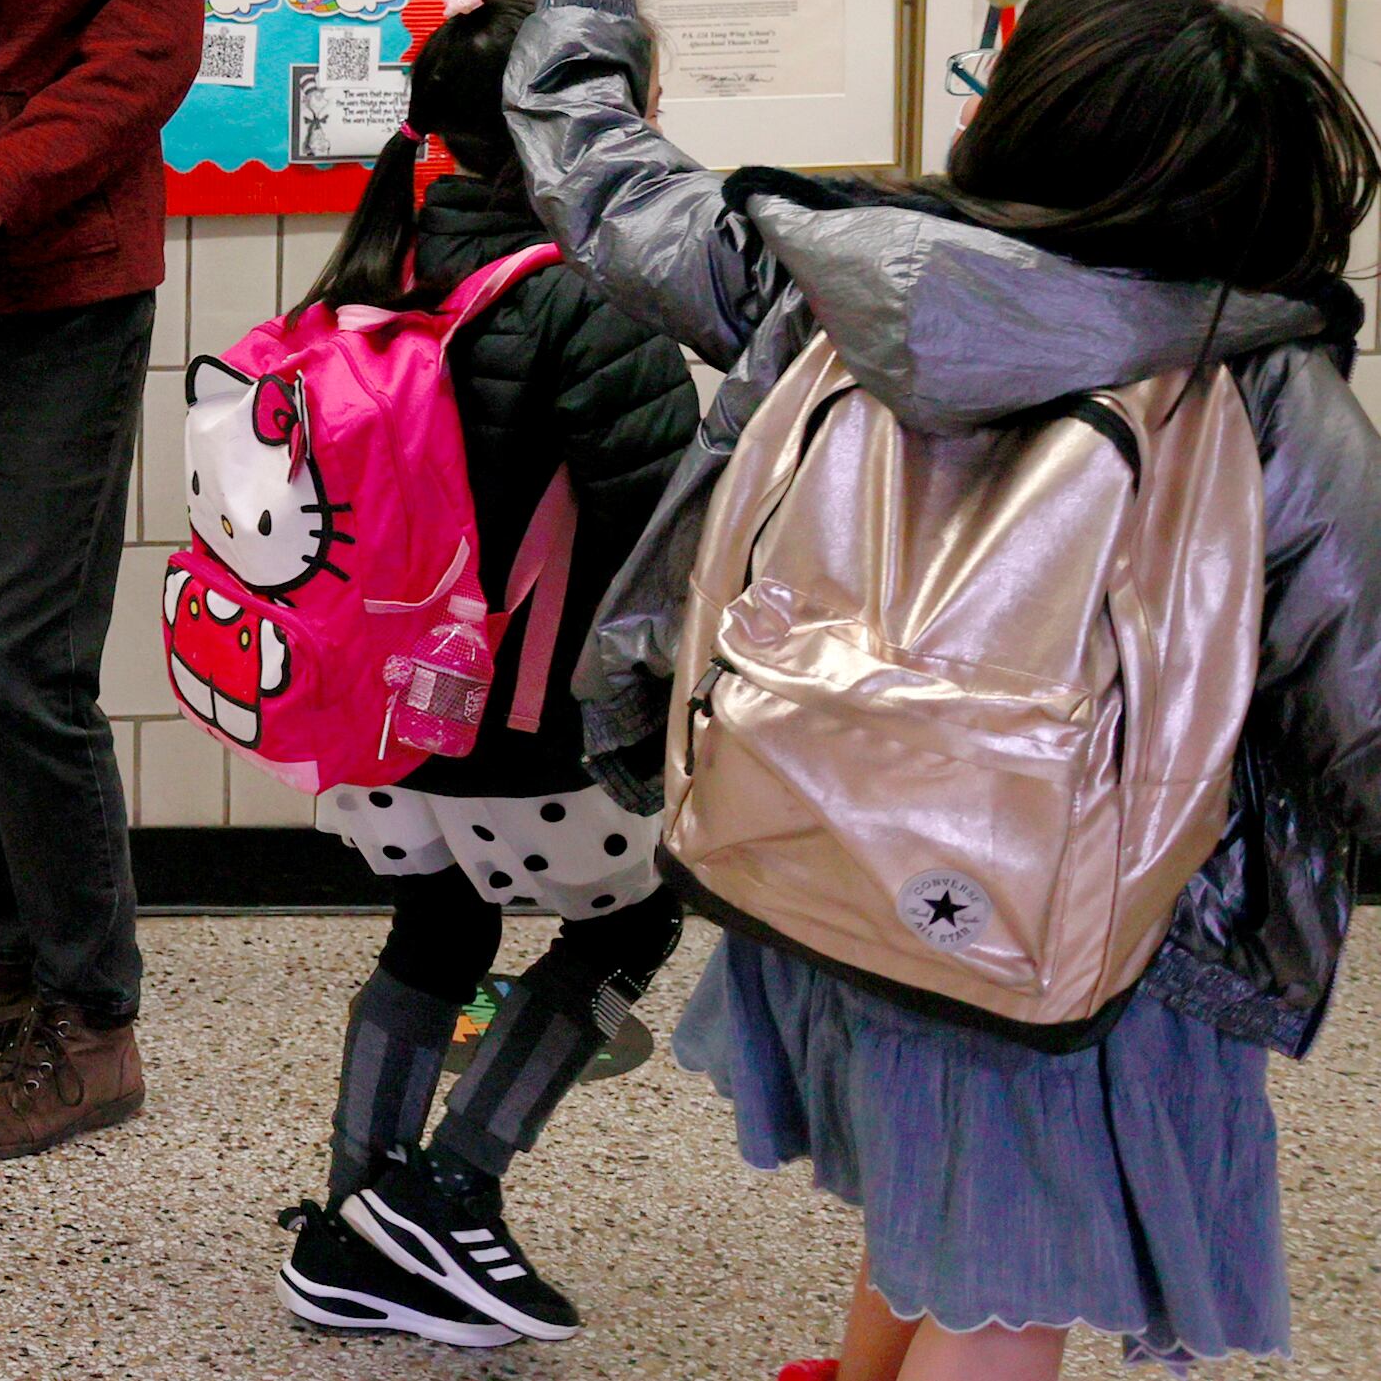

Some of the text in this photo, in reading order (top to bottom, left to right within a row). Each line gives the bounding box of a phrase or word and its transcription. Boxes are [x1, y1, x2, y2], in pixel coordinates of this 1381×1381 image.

[913, 879, 979, 903] CONVERSE
[913, 922, 972, 943] ALL STAR
